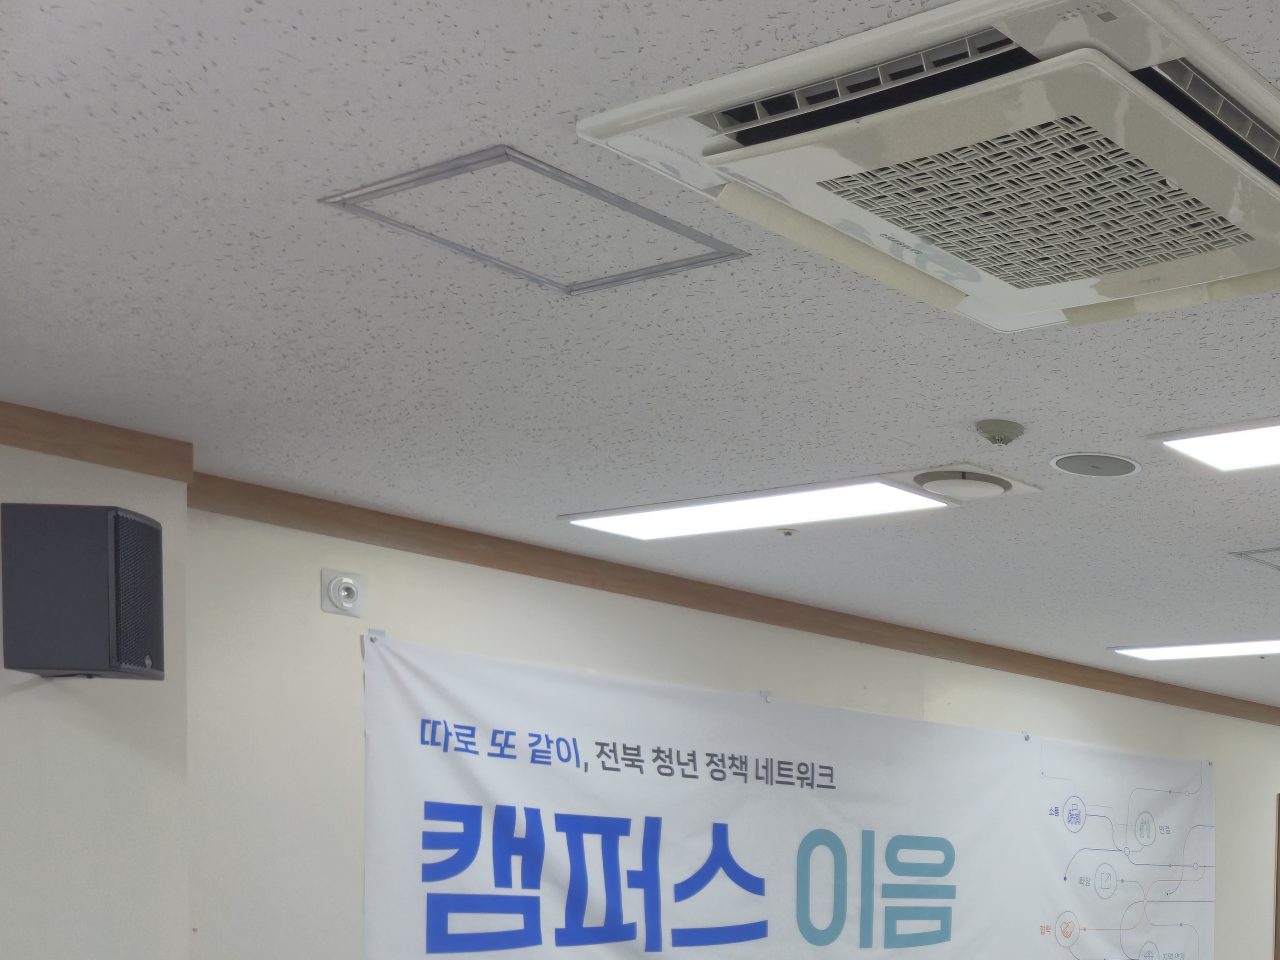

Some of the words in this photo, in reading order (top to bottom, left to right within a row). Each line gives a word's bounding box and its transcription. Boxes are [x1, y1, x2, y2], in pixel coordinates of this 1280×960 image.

[420, 718, 480, 756] 따로
[487, 729, 518, 760] 또
[528, 732, 589, 772] 같이,
[594, 740, 645, 775] 전북
[651, 746, 700, 780] 청년
[705, 751, 748, 784] 정책
[755, 756, 837, 790] 네트워크
[421, 800, 769, 955] 캠퍼스
[795, 828, 957, 949] 이음
